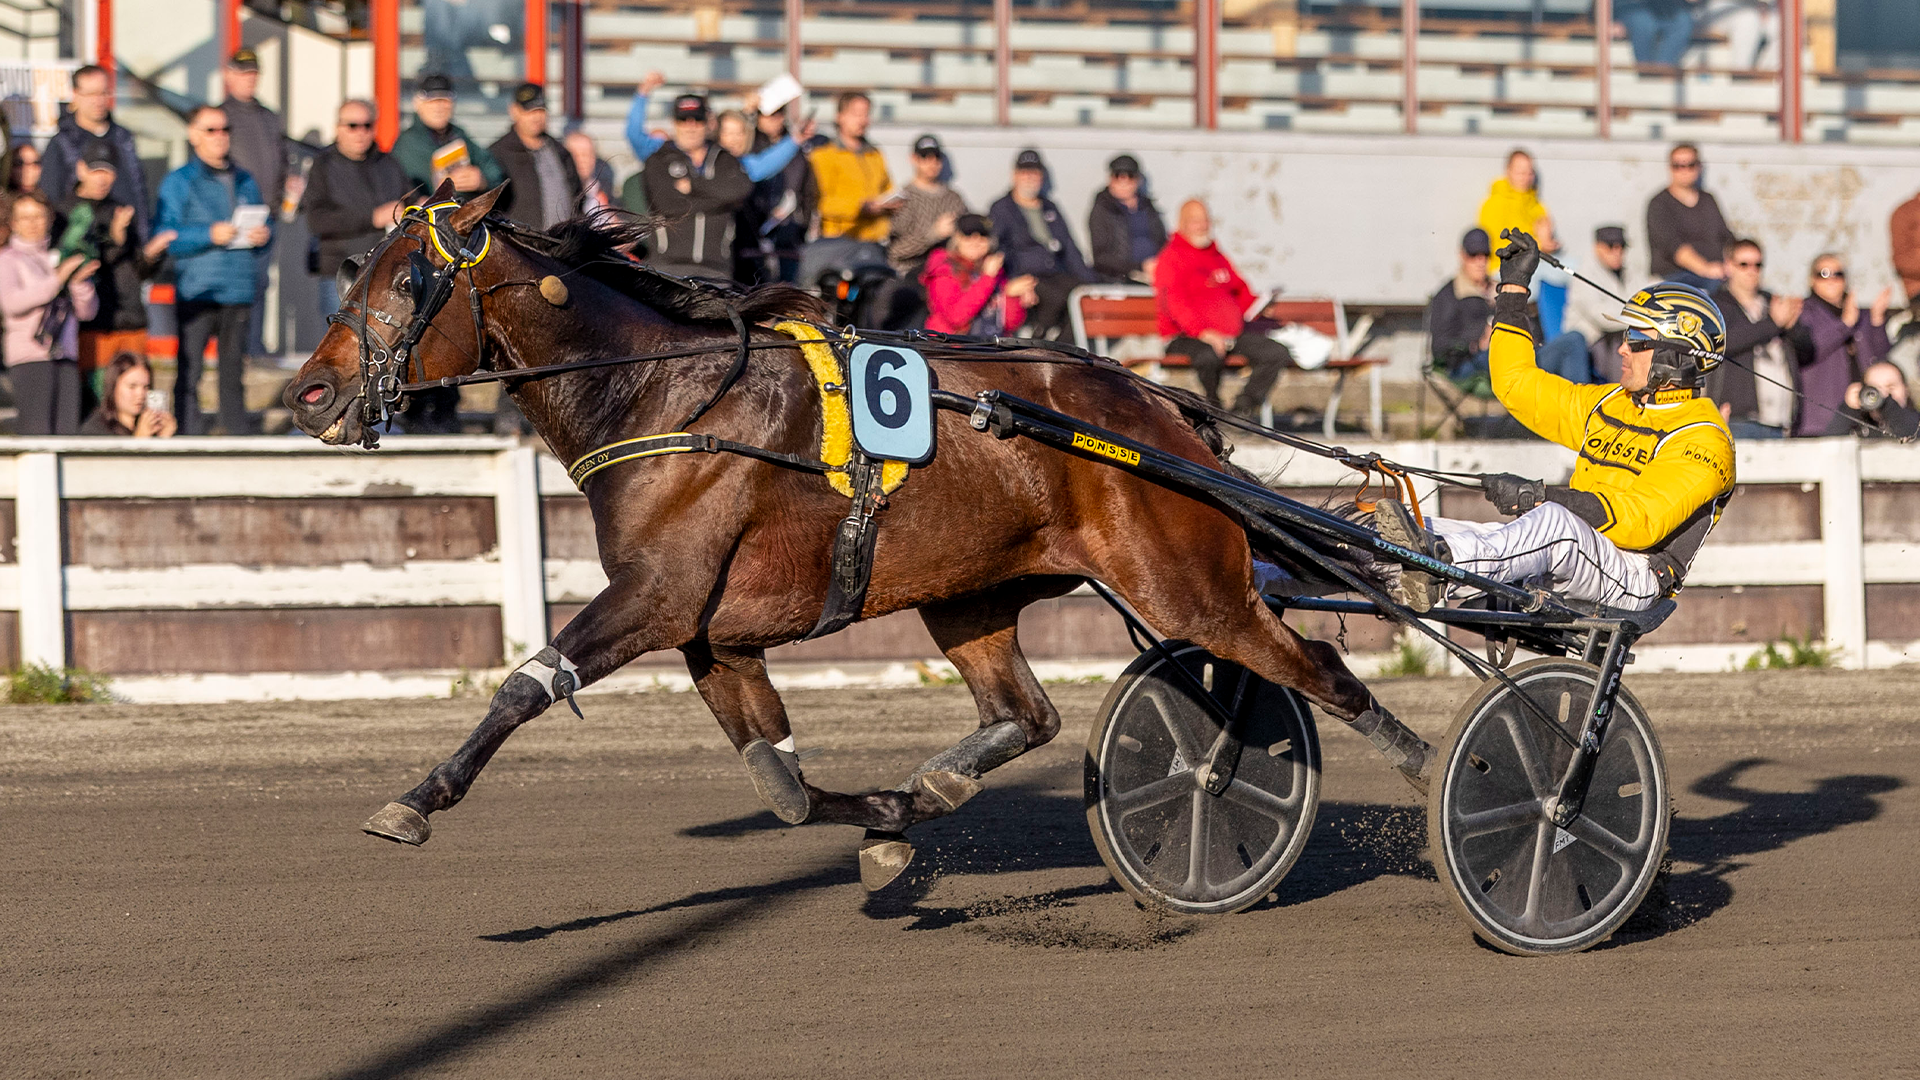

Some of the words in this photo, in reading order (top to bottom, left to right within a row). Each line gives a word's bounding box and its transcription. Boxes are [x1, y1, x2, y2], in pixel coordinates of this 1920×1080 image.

[865, 349, 912, 430] 6
[597, 451, 610, 463] OY
[1075, 435, 1138, 462] PONSSE
[1587, 437, 1648, 466] ONSSE
[1555, 834, 1570, 850] FMT
